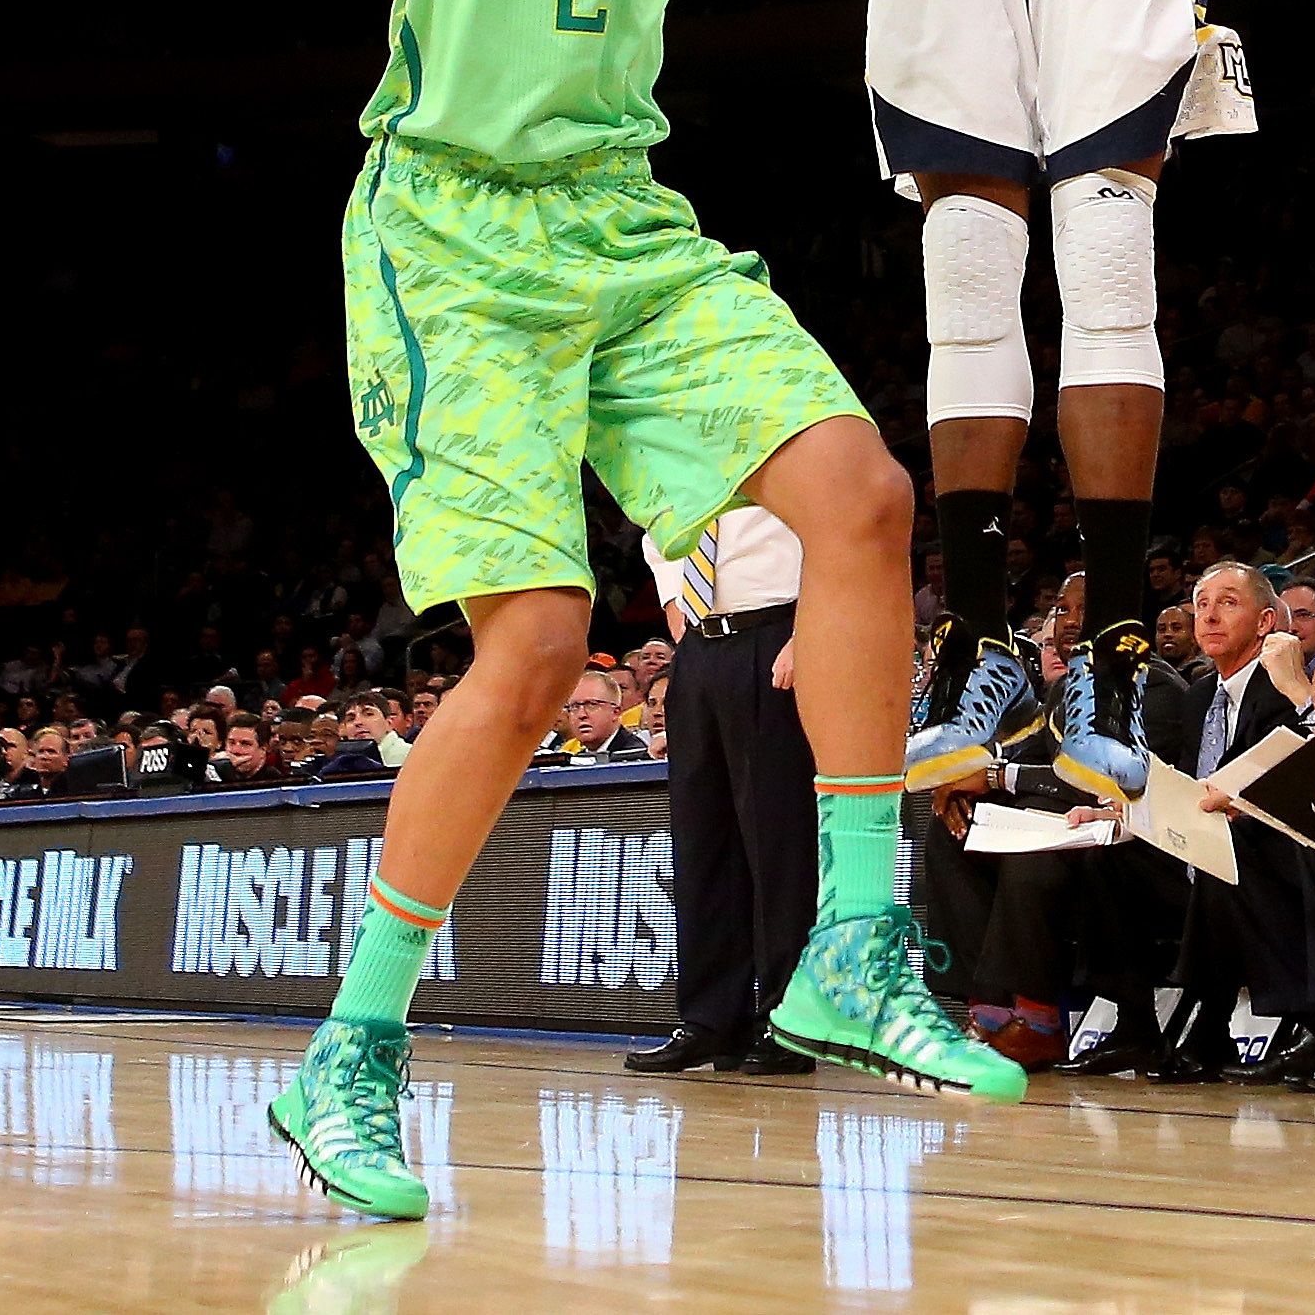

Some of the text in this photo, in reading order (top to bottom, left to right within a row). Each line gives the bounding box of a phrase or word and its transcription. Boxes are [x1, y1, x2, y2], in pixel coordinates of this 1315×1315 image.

[139, 747, 169, 773] POSS
[33, 849, 126, 971] MILK
[171, 843, 338, 978] MUSCLE
[539, 827, 679, 991] MUS
